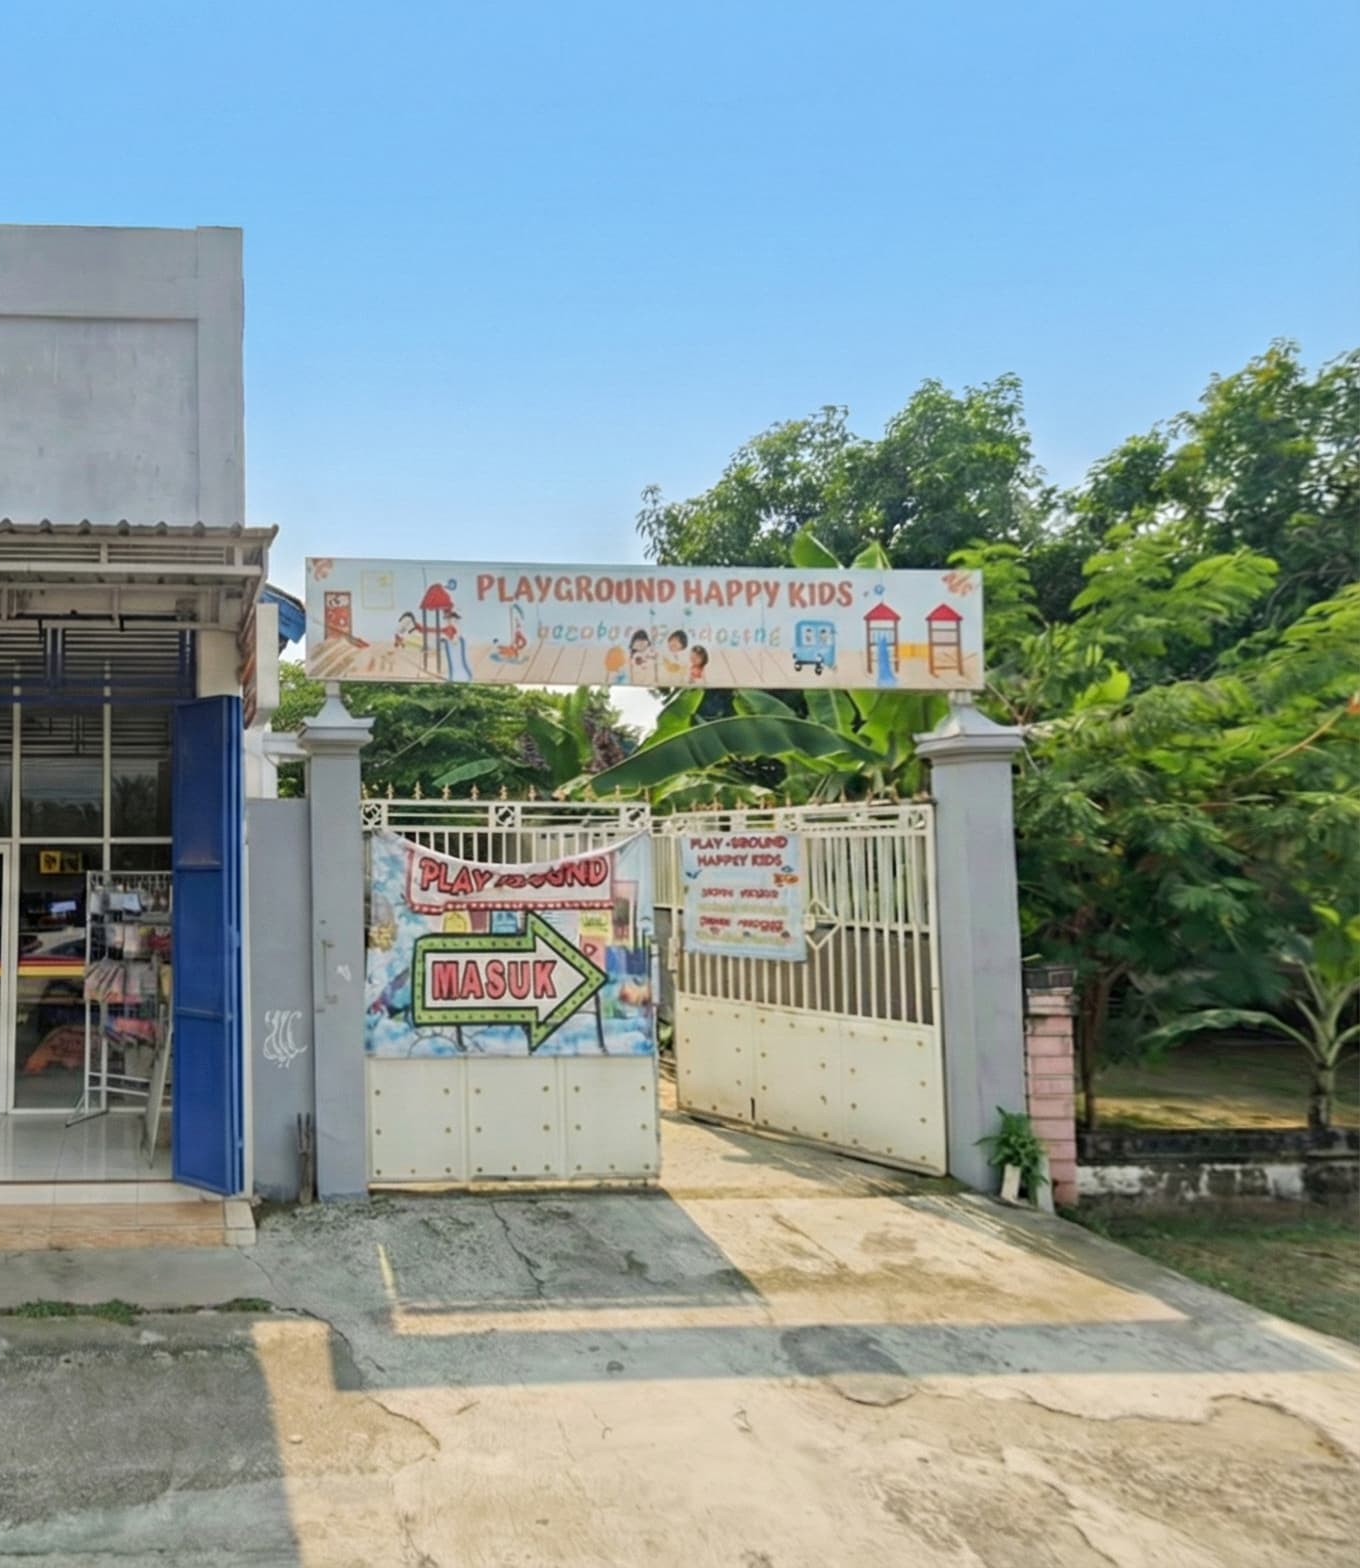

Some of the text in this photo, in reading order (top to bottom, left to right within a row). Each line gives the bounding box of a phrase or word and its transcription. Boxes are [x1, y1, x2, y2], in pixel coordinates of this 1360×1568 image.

[476, 574, 853, 607] PLAYGROUND HAPPY KIDS
[430, 957, 558, 1001] MASUK
